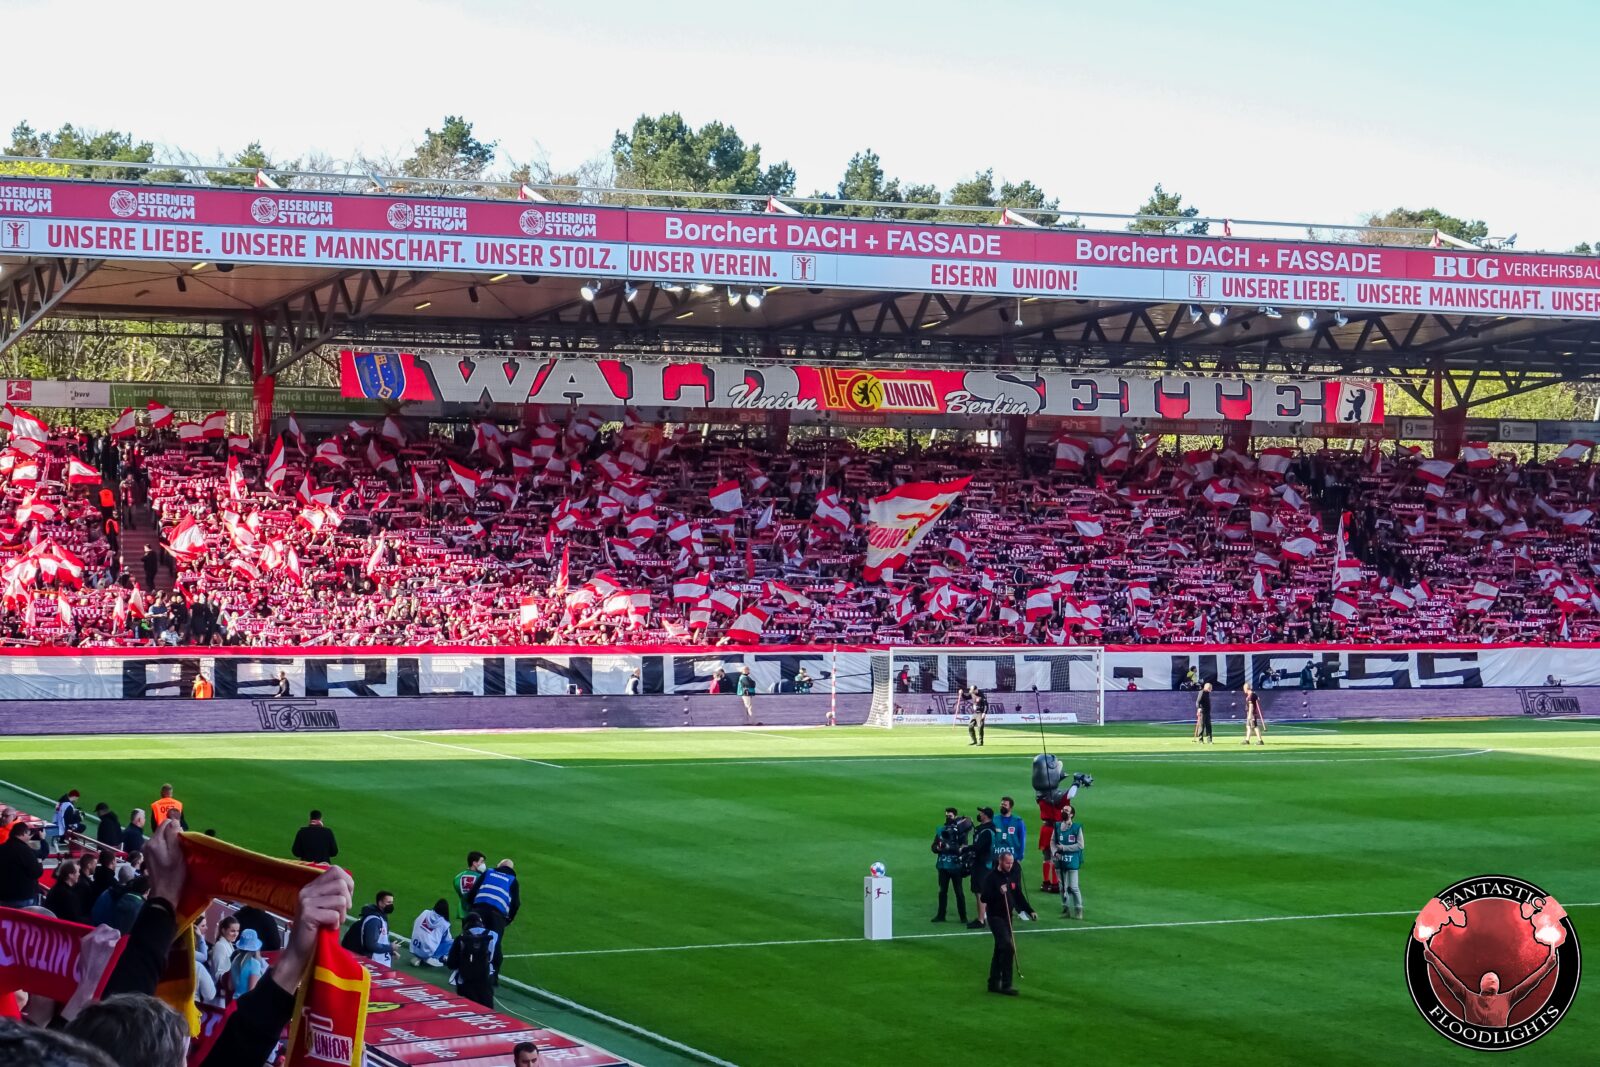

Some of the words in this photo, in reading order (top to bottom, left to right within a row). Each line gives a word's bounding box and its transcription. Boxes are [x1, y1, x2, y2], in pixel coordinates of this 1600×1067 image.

[0, 186, 52, 200] ISERNER
[138, 192, 194, 207] EISERNER
[278, 199, 334, 213] EISERNER
[414, 205, 467, 218] EISERNER
[545, 211, 597, 225] EISERNER
[48, 223, 136, 251] UNSERE
[142, 228, 210, 255] LIEBE.
[221, 231, 306, 258] UNSERE
[315, 235, 466, 264] MANNSCHAFT.
[475, 242, 548, 267] UNSER
[550, 245, 617, 270] STOLZ.
[665, 217, 777, 245] Borchert
[786, 223, 857, 250] DACH
[864, 234, 879, 250] +
[887, 230, 1001, 256] FASSADE
[629, 249, 694, 274] UNSER
[700, 252, 778, 278] VEREIN.
[1076, 239, 1178, 264] Borchert
[1186, 245, 1250, 268] DACH
[1257, 254, 1270, 268] +
[1276, 248, 1381, 274] FASSADE
[1432, 255, 1500, 280] BUG
[1504, 262, 1600, 281] VERKEHRSBAU
[932, 263, 997, 288] EISERN
[1012, 267, 1078, 291] UNION!
[1222, 277, 1289, 300] UNSERE
[1293, 279, 1346, 302] LIEBE.
[1356, 283, 1422, 306] UNSERE
[1429, 286, 1545, 310] MANNSCHAFT.
[414, 354, 801, 407] WALD
[881, 380, 937, 408] UNION
[199, 391, 248, 400] vergessen
[728, 383, 818, 411] Union
[944, 390, 1030, 415] Berlin
[963, 368, 1328, 422] SEITE
[122, 655, 593, 699] BERLIN
[642, 653, 824, 696] IST
[302, 709, 339, 728] UNION
[1553, 696, 1581, 714] UNION
[994, 846, 1015, 855] HOST
[438, 1011, 511, 1030] gibt's
[314, 1030, 350, 1061] UNION
